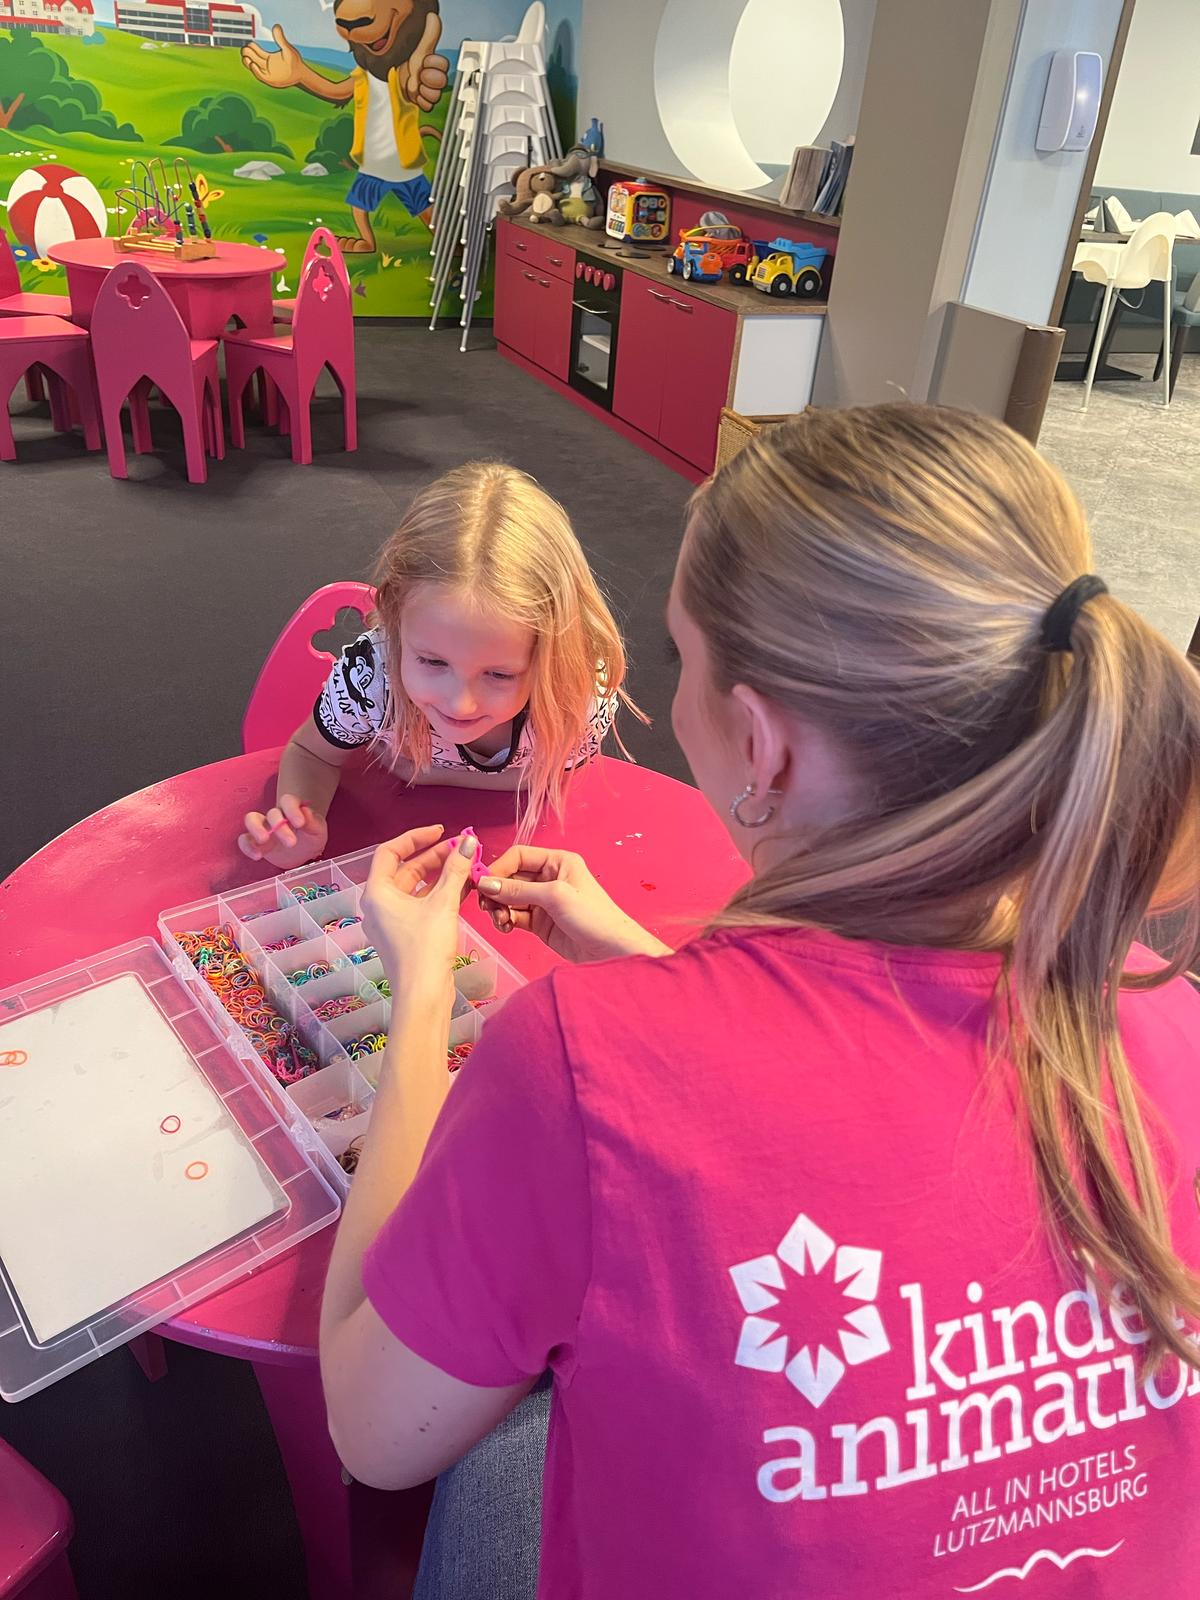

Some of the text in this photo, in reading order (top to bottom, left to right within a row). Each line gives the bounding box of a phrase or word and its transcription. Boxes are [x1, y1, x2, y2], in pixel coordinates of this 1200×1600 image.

[900, 1249, 1185, 1400] kinde
[933, 1472, 1148, 1558] LUTZMANNSBURG
[951, 1444, 1137, 1522] ALL IN HOTELS
